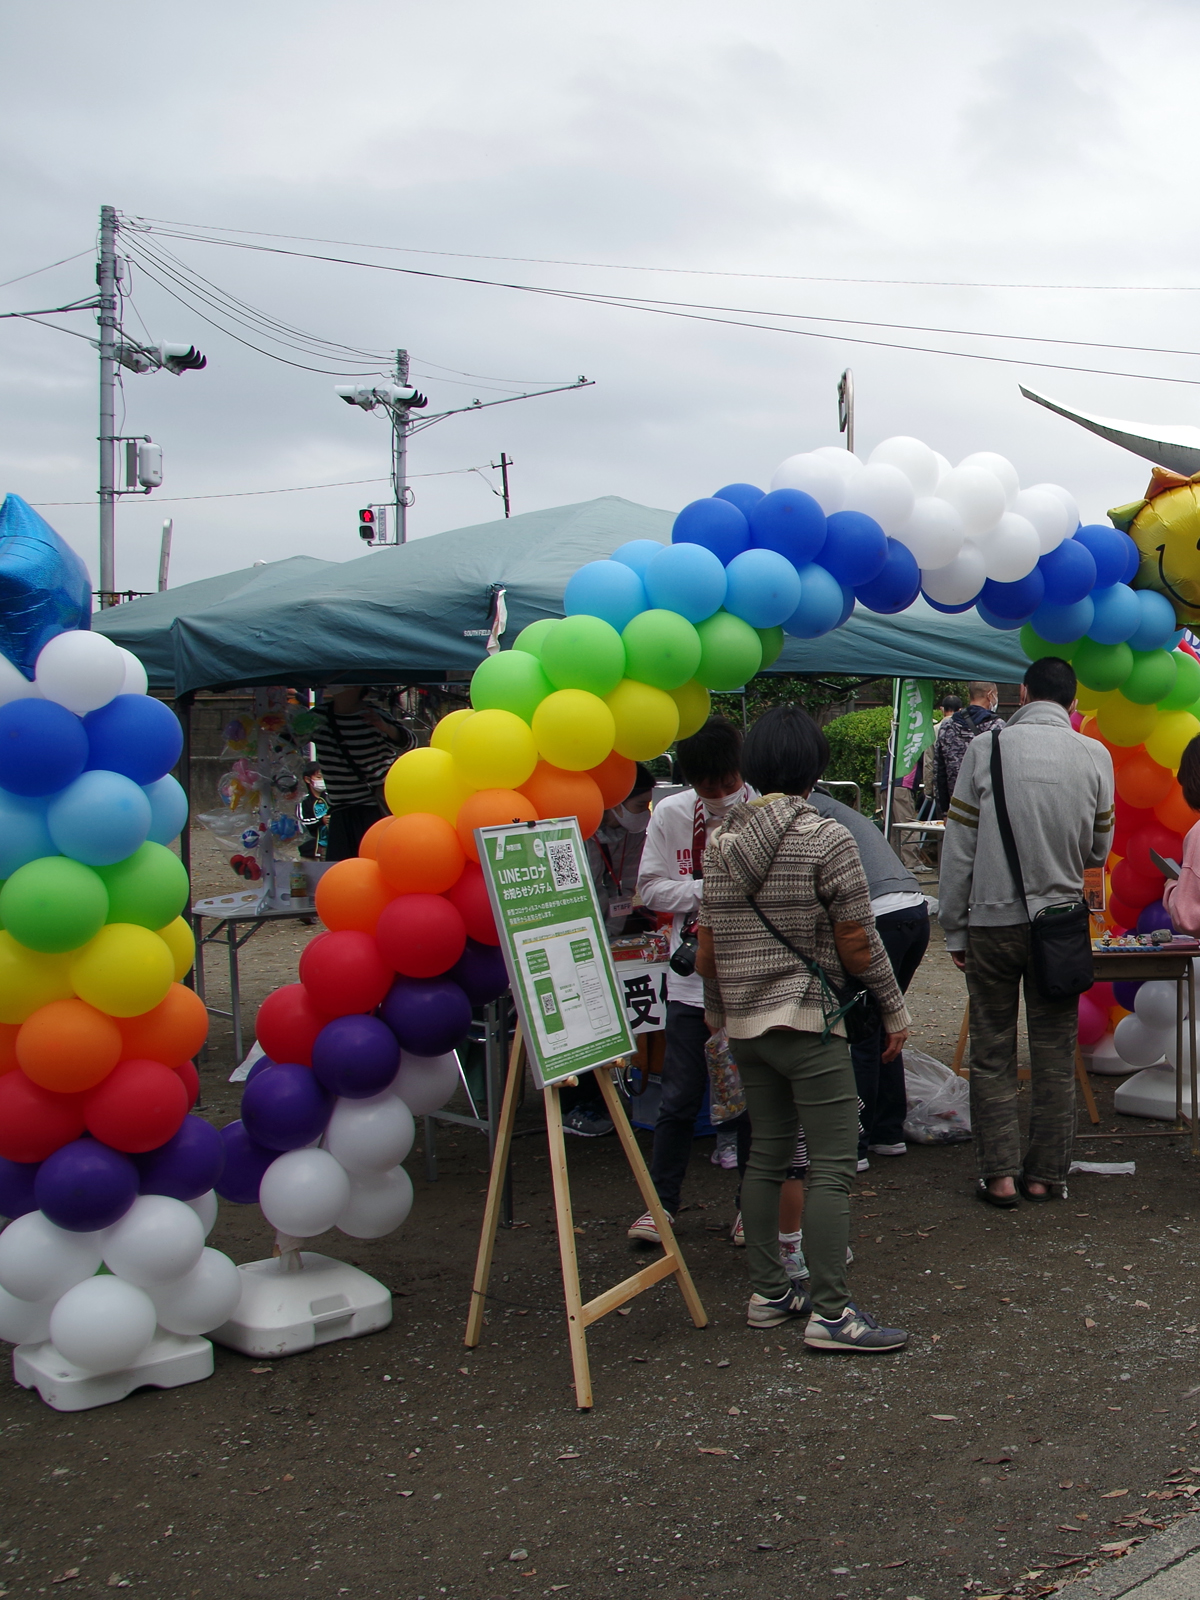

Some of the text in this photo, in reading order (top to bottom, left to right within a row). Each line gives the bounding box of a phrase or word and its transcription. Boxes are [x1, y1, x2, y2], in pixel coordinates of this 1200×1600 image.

[463, 629, 478, 637] SOUTH
[498, 864, 547, 885] LINEコロナ
[503, 882, 553, 900] お知らせシステム
[613, 903, 632, 912] STAFF
[623, 972, 669, 1030] 受
